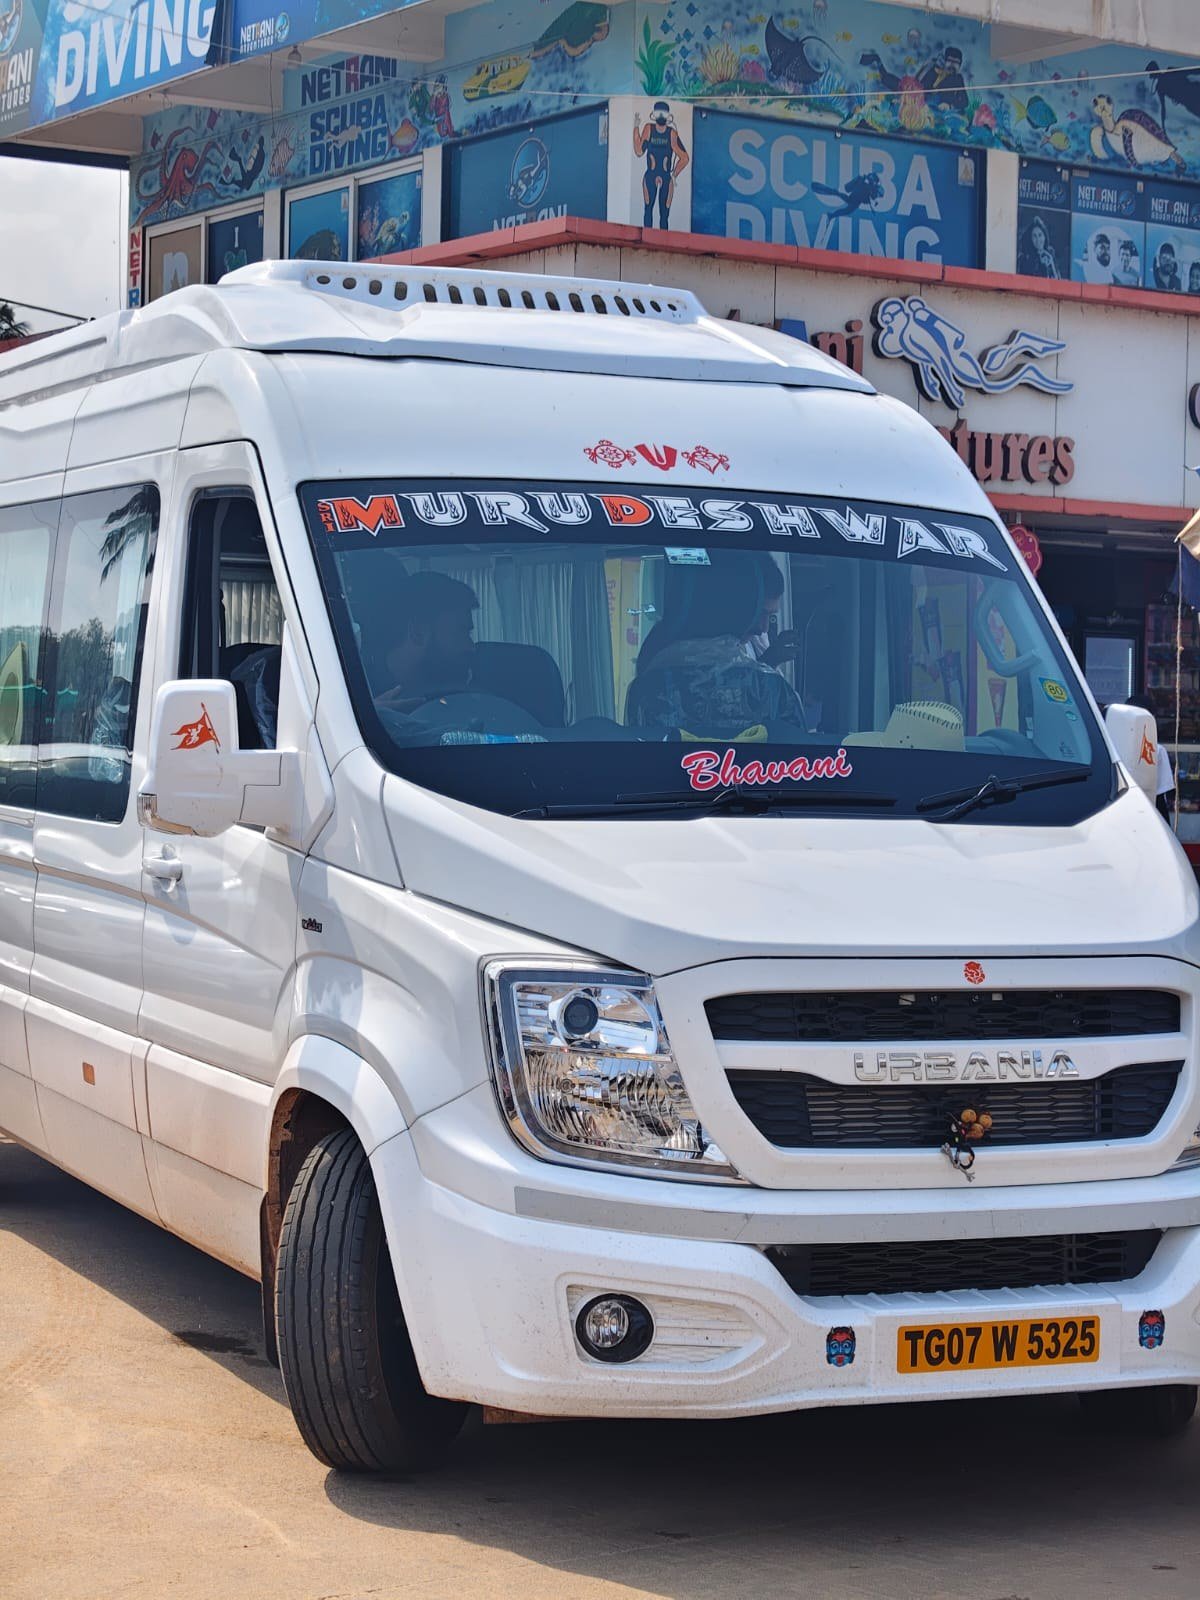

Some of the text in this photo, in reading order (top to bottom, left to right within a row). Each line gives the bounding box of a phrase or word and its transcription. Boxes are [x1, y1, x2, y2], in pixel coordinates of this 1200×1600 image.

[55, 0, 216, 107] DIVING
[301, 55, 397, 106] NETRANI
[311, 94, 387, 144] SCUBA
[309, 126, 387, 175] DIVING
[728, 128, 941, 221] SCUBA
[317, 502, 336, 532] SRI
[318, 491, 1009, 572] MURUDESHWAR
[681, 748, 853, 792] Bhavani
[853, 1049, 1080, 1083] URBANIA
[904, 1319, 1096, 1367] TG07 W 5325
